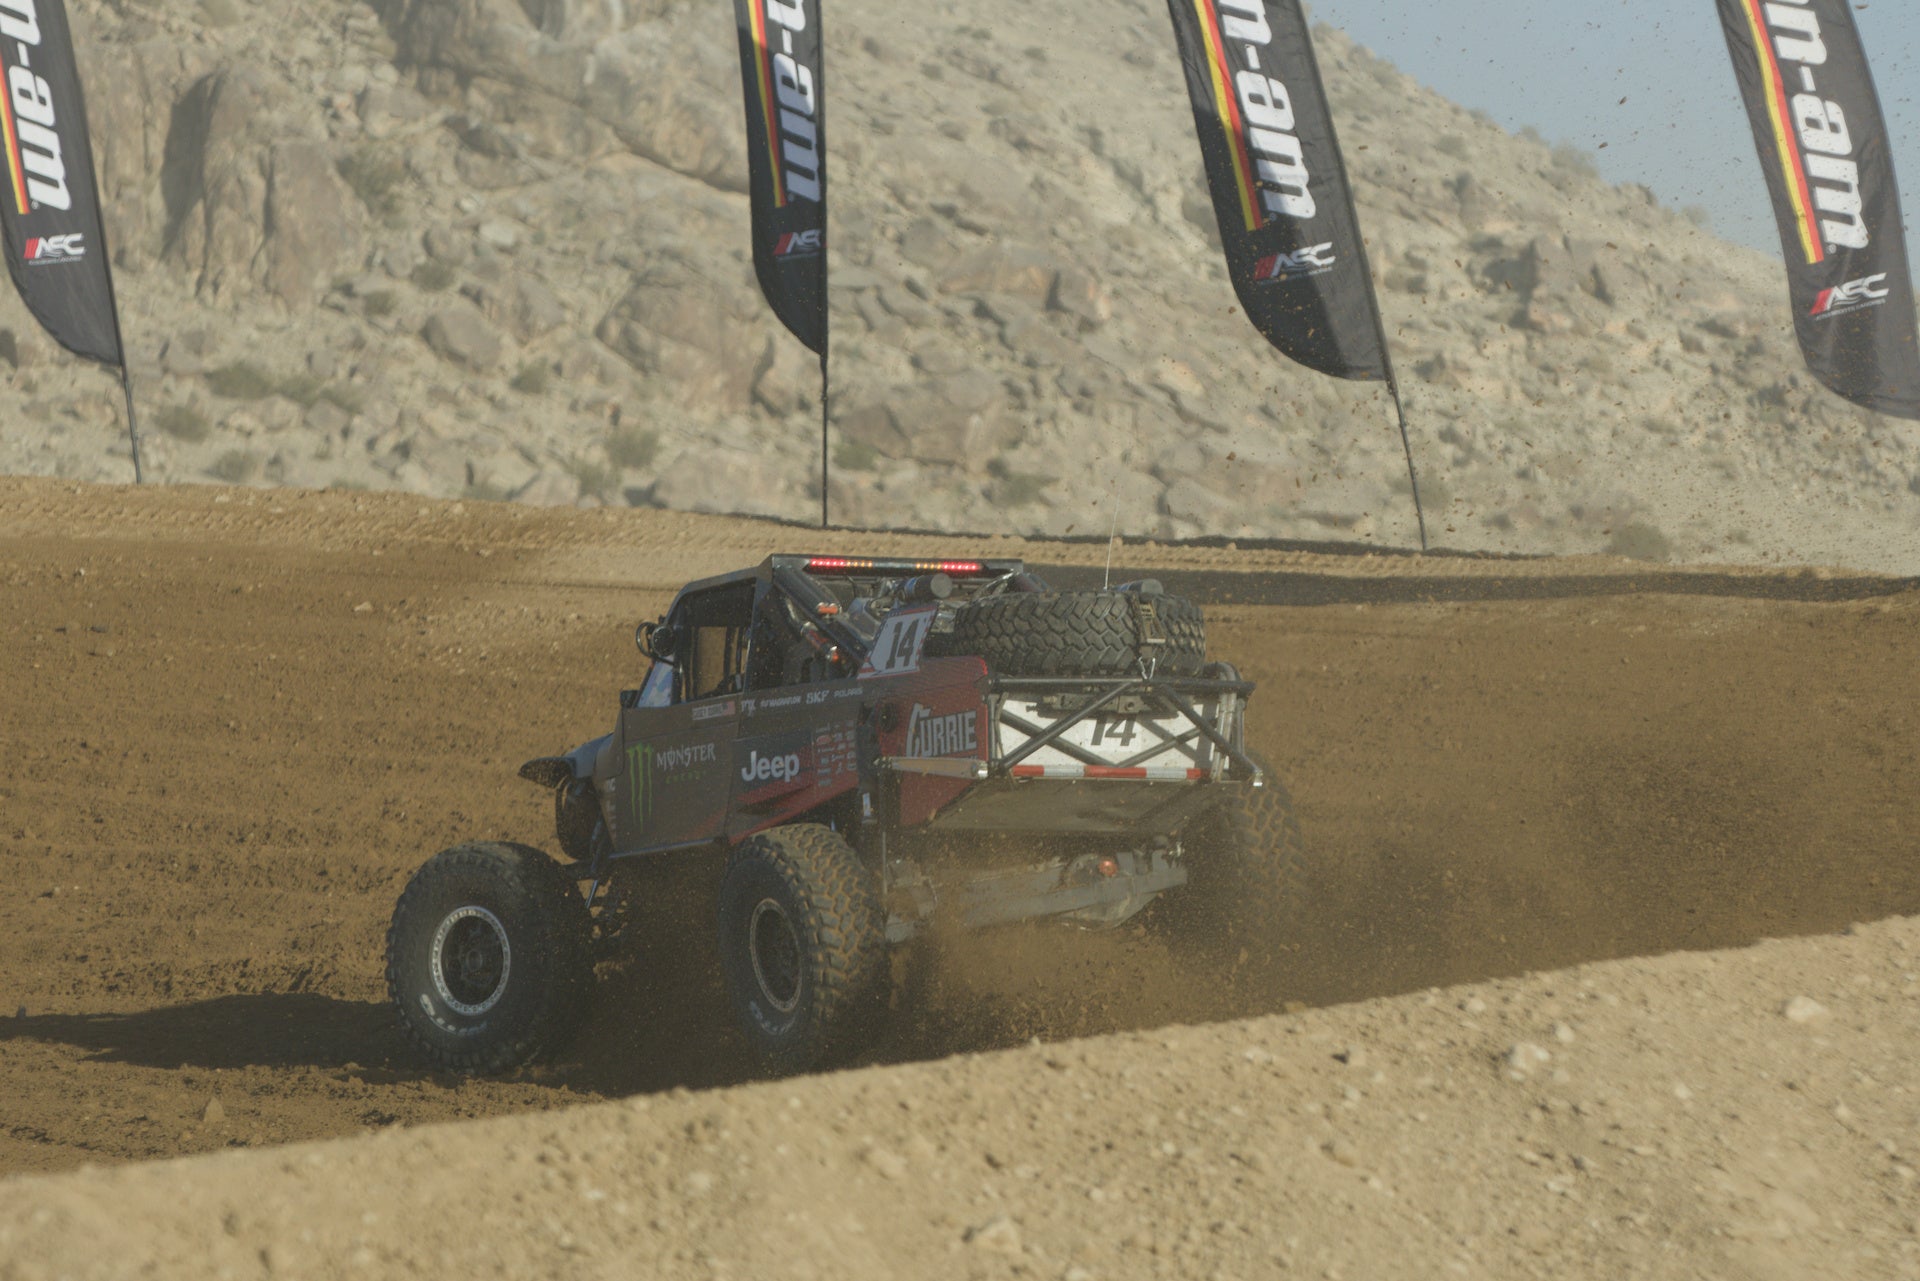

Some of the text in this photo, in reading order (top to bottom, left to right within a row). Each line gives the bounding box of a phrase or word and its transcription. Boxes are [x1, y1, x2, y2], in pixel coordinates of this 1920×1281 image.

[1764, 0, 1870, 249] n-am
[885, 619, 920, 669] 14
[905, 702, 977, 758] CURRIE
[1090, 715, 1137, 746] 14
[656, 742, 717, 771] MONSTER
[741, 750, 800, 783] Jeep
